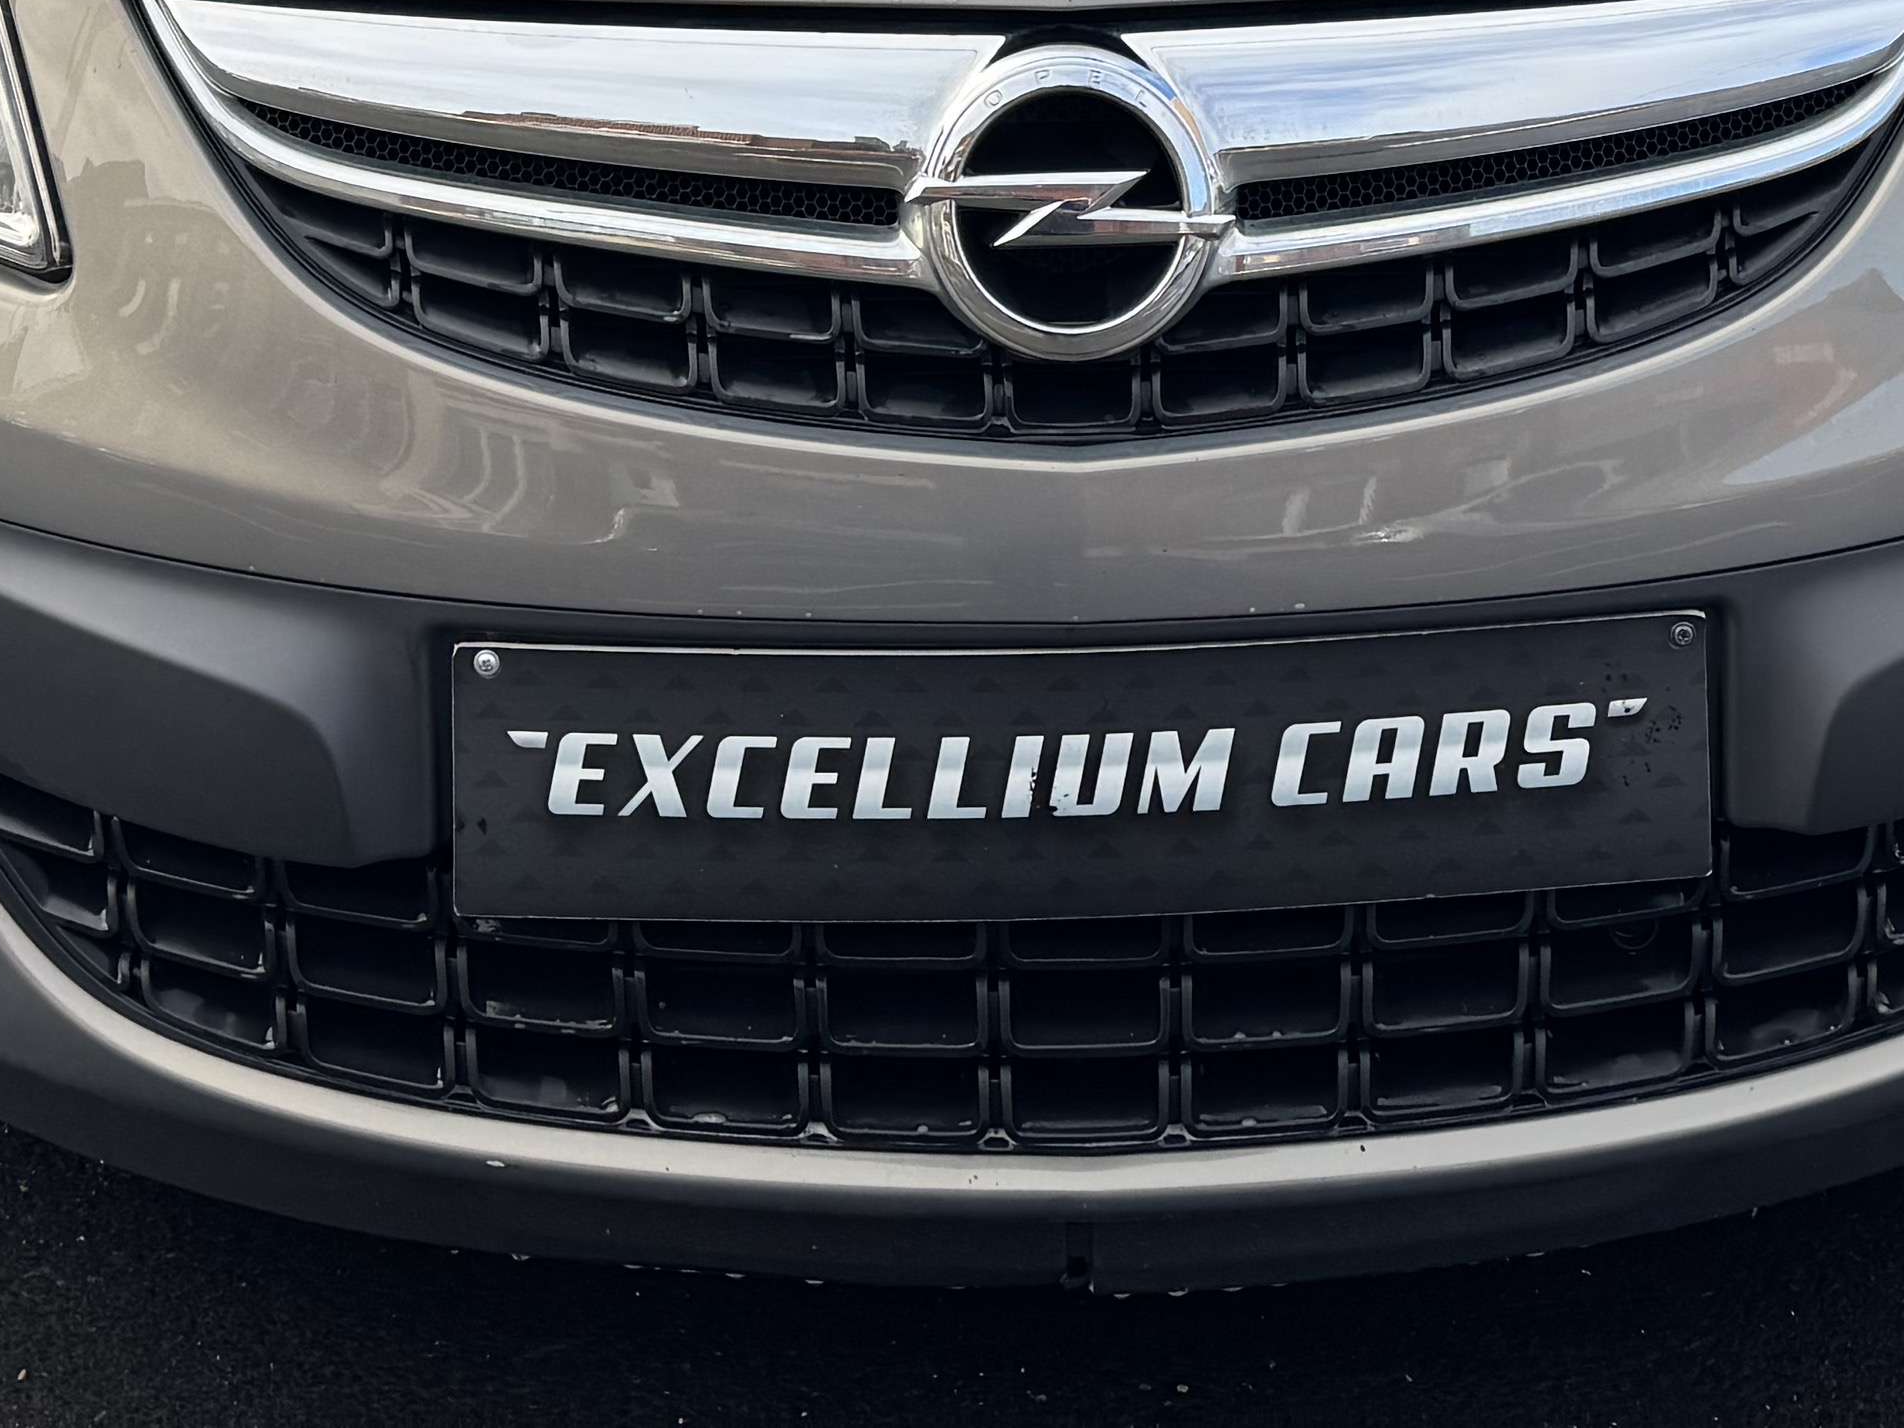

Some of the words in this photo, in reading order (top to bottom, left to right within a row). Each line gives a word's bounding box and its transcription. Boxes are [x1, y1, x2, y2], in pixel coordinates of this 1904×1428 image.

[982, 67, 1149, 110] OPEL
[548, 728, 1237, 821] EXCELLIUM
[1270, 700, 1597, 807] CARS
